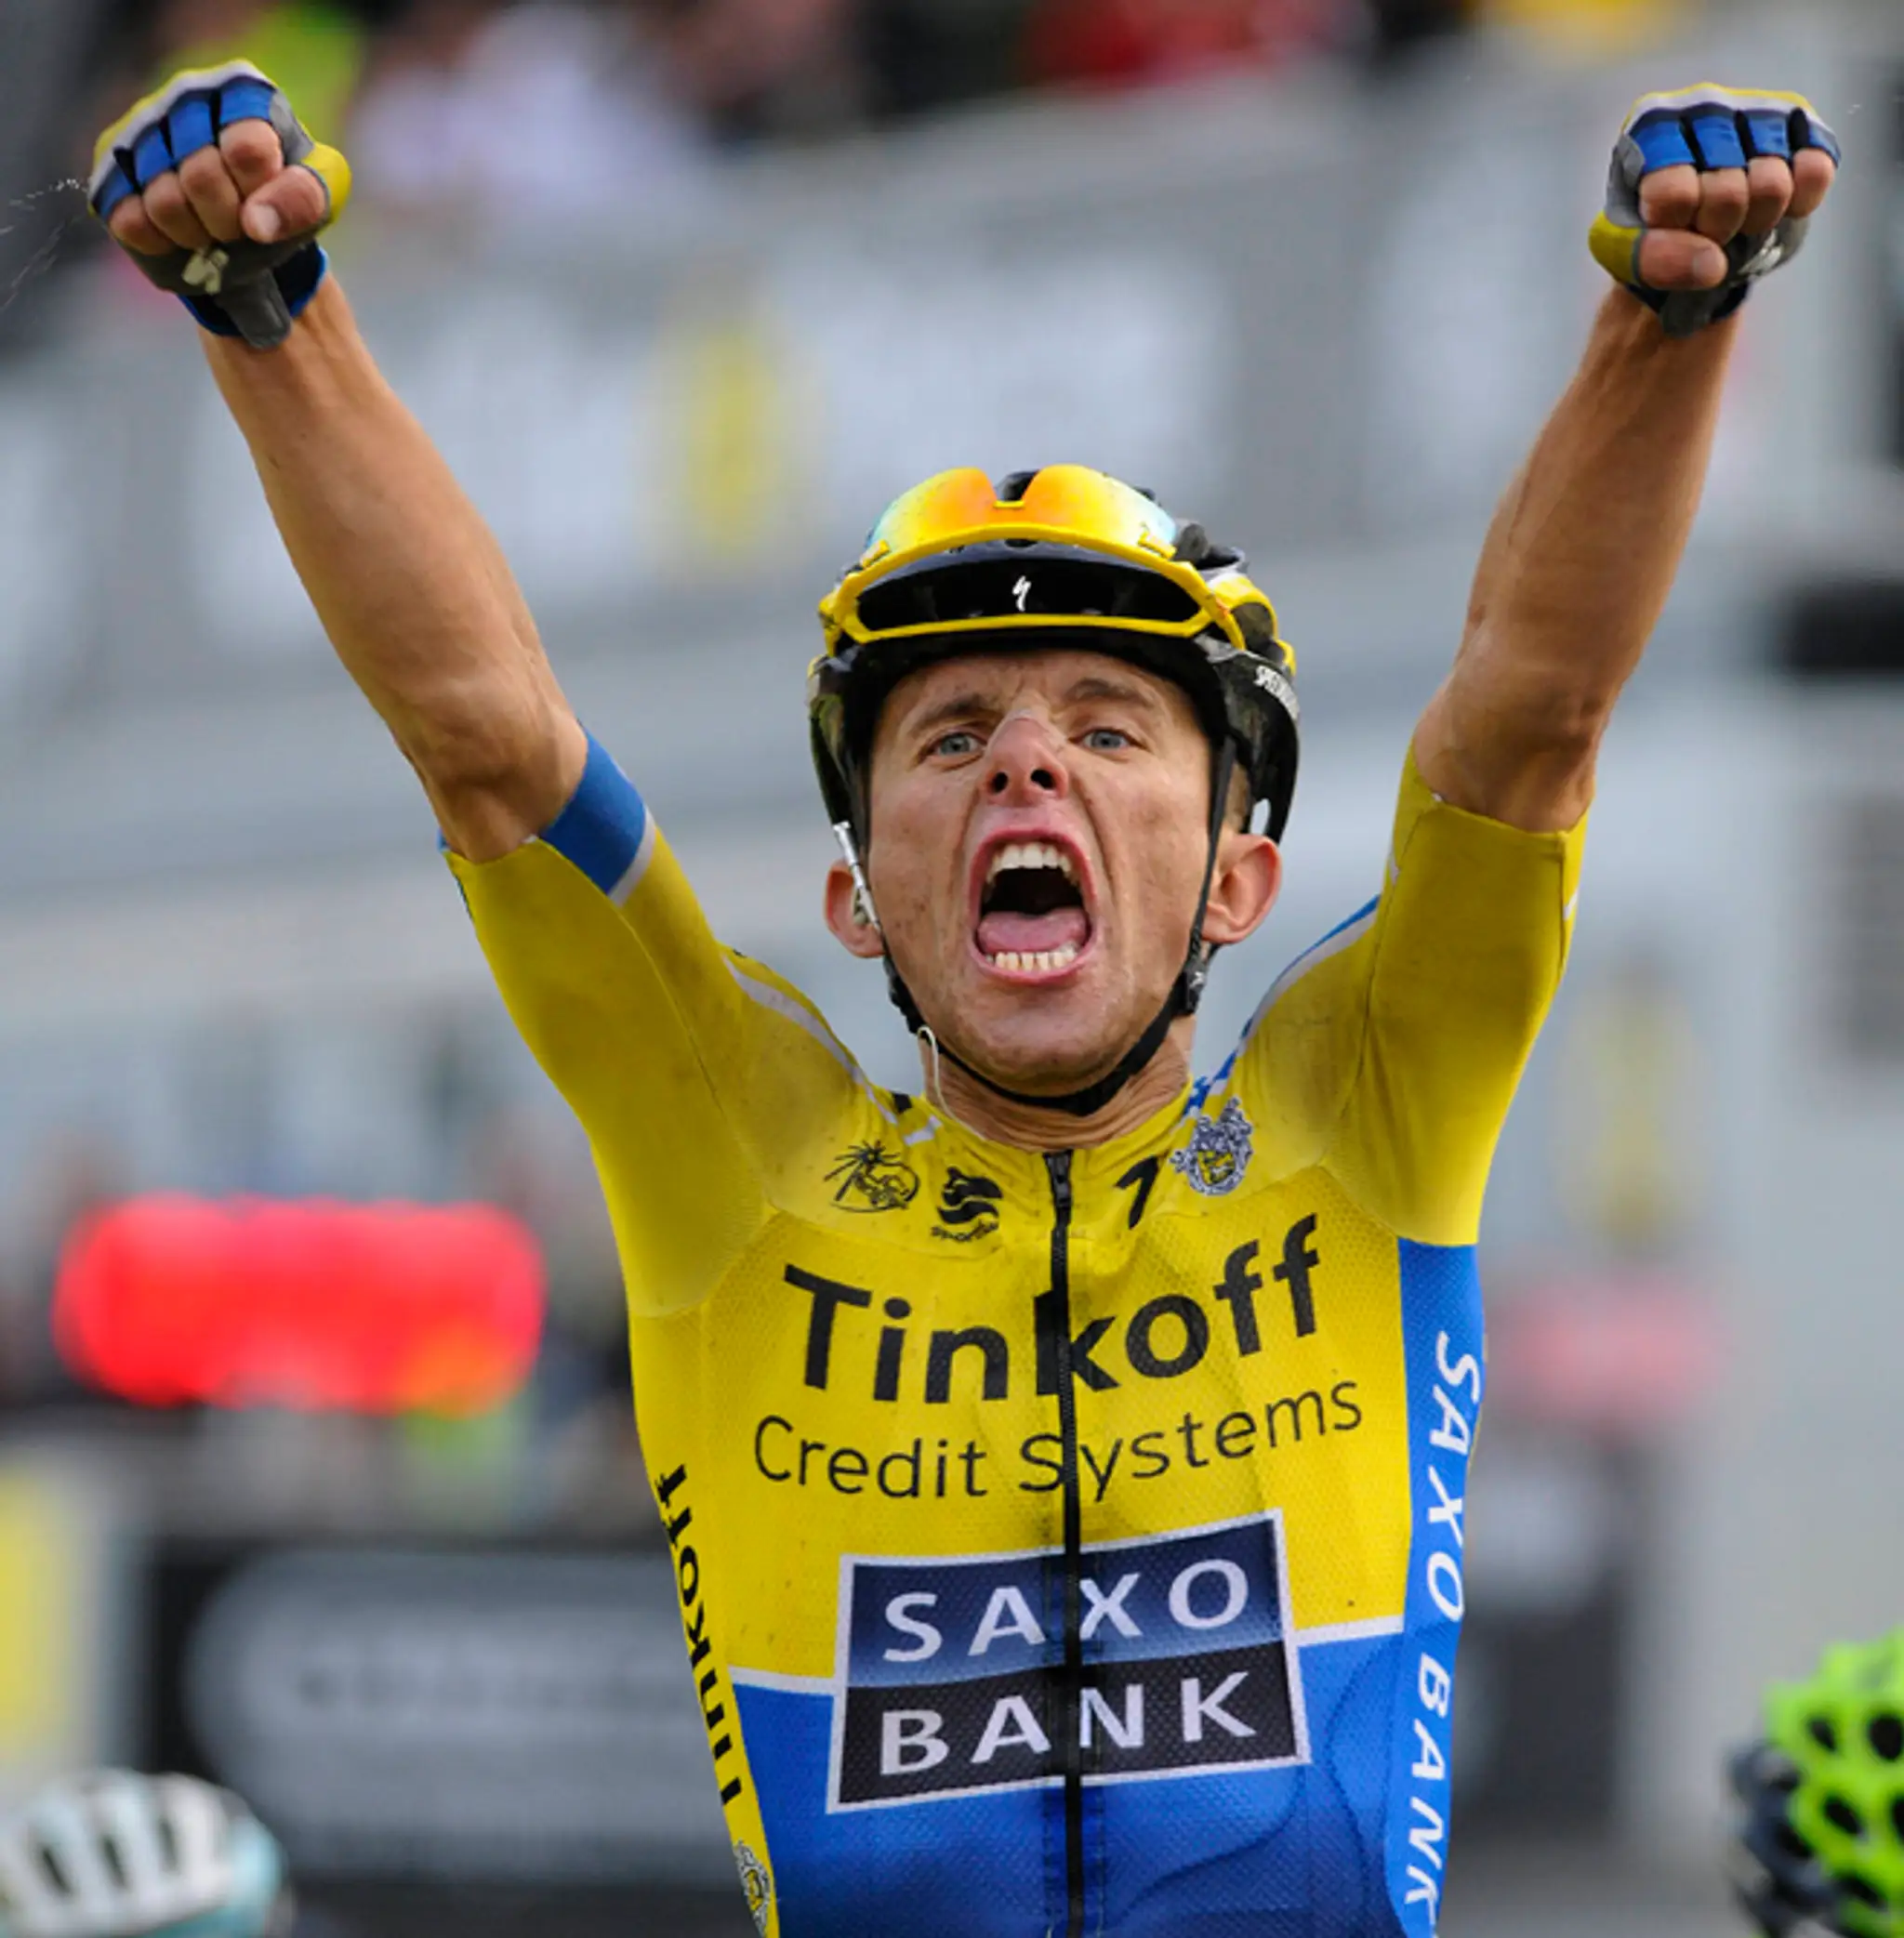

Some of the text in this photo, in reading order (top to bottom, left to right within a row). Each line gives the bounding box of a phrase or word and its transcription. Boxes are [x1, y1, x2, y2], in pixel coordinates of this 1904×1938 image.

[785, 1214, 1320, 1404] Tinkoff
[753, 1380, 1363, 1502] Credit Systems
[883, 1559, 1250, 1662] SAXO
[1405, 1331, 1481, 1927] SAXO BANK
[879, 1671, 1257, 1776] BANK
